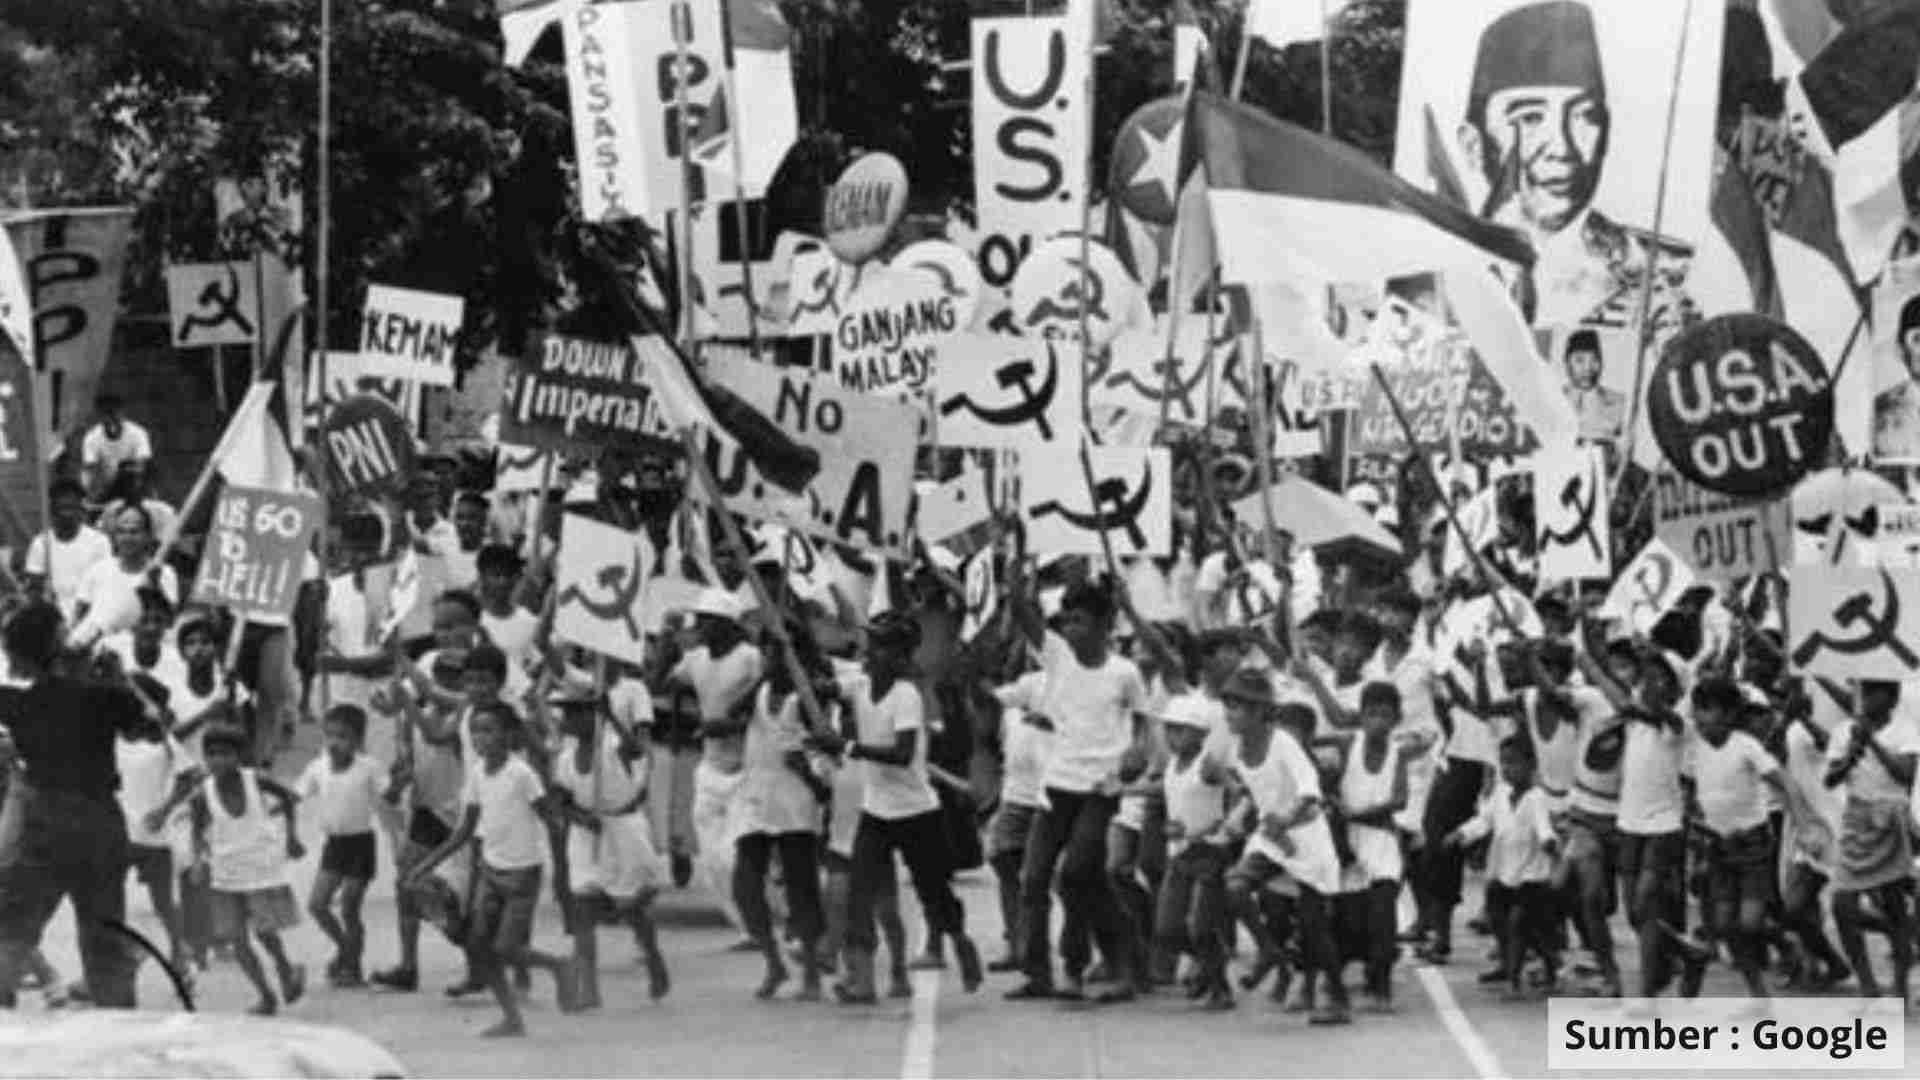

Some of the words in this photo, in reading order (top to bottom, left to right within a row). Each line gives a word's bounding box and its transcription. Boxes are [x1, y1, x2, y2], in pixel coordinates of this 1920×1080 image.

[543, 335, 627, 384] DOWN
[1667, 341, 1828, 423] U.S.A.
[775, 377, 842, 433] No
[328, 417, 397, 490] PNI
[1691, 414, 1802, 477] OUT
[1693, 516, 1756, 569] OUT
